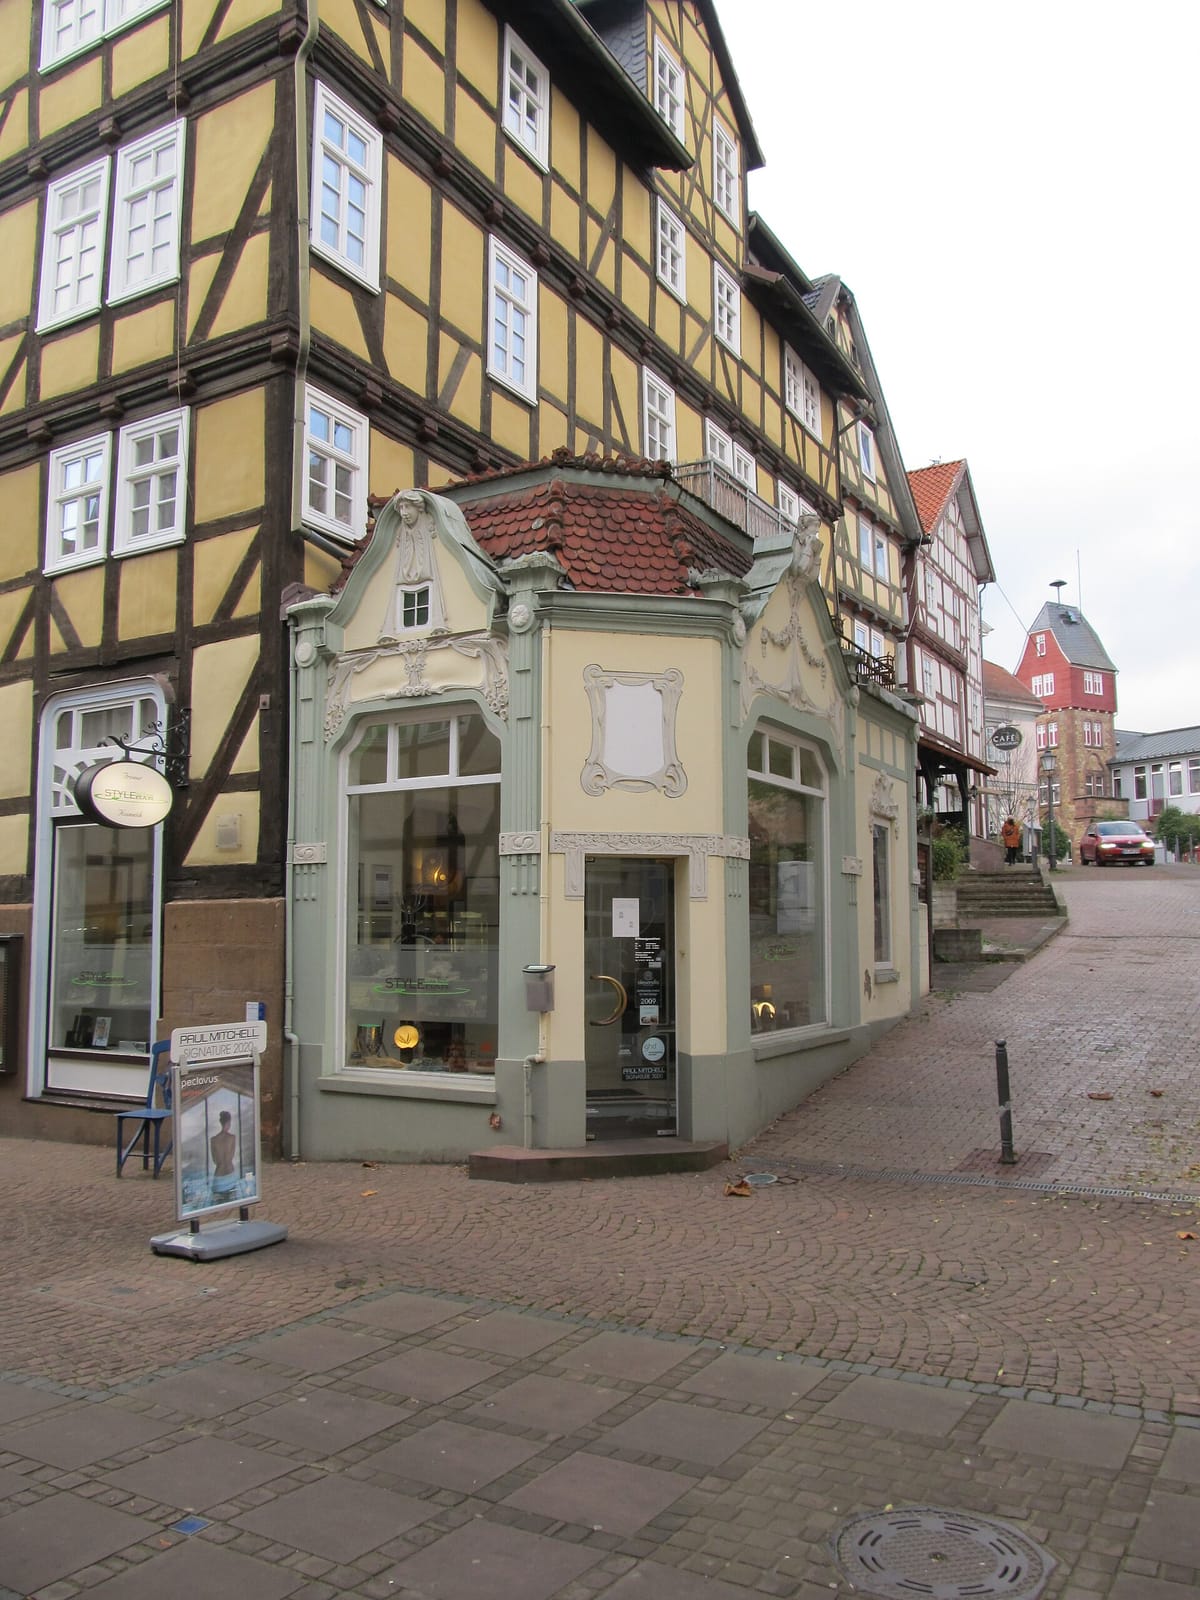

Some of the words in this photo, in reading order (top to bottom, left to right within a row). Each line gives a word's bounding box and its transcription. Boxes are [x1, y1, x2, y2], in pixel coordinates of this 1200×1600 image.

[180, 1034, 208, 1044] PAUL
[209, 1028, 259, 1041] MITCHELL
[183, 1044, 231, 1058] SIGNATURE
[233, 1041, 254, 1054] 2020
[181, 1075, 219, 1088] peclavus
